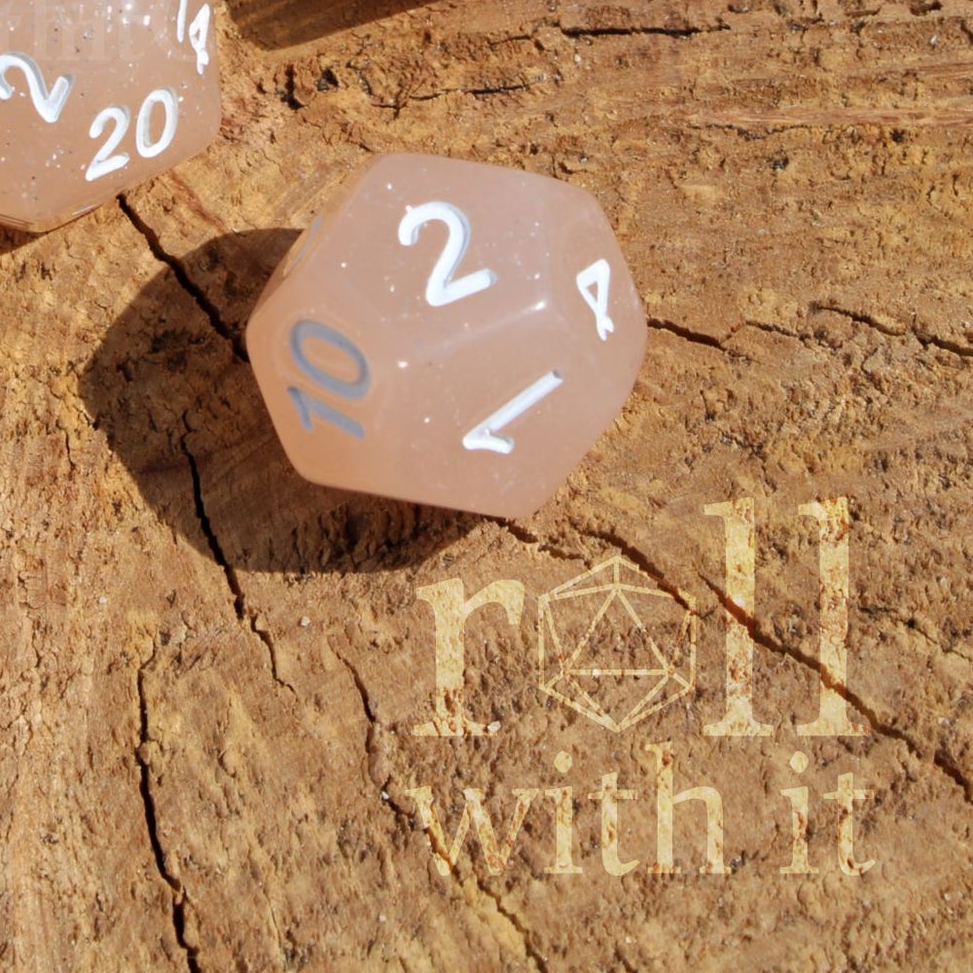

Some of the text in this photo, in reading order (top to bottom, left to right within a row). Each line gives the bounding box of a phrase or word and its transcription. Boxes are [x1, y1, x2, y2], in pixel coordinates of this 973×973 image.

[85, 87, 179, 181] 20
[398, 201, 497, 307] 2
[576, 258, 615, 342] 4
[287, 319, 371, 441] 10
